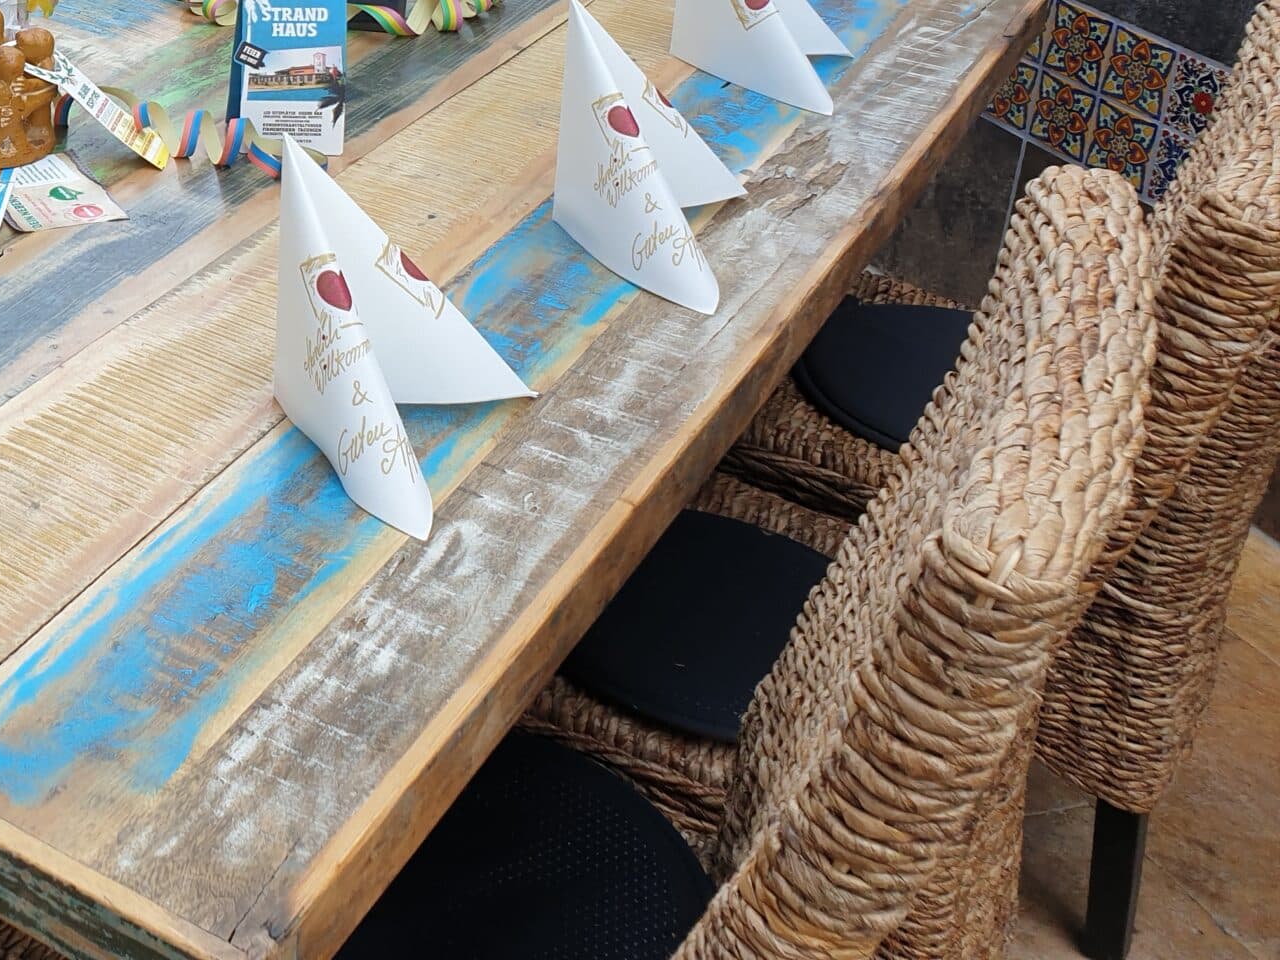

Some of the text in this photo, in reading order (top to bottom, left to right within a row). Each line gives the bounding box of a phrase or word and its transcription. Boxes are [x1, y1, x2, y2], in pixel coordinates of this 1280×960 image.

[262, 7, 329, 22] STRAND
[271, 23, 318, 38] HAUS
[607, 160, 659, 208] Willkomm
[644, 192, 663, 213] &
[632, 220, 681, 271] Guten
[314, 339, 371, 394] Willkomm
[352, 380, 373, 406] &
[337, 416, 393, 477] Guten
